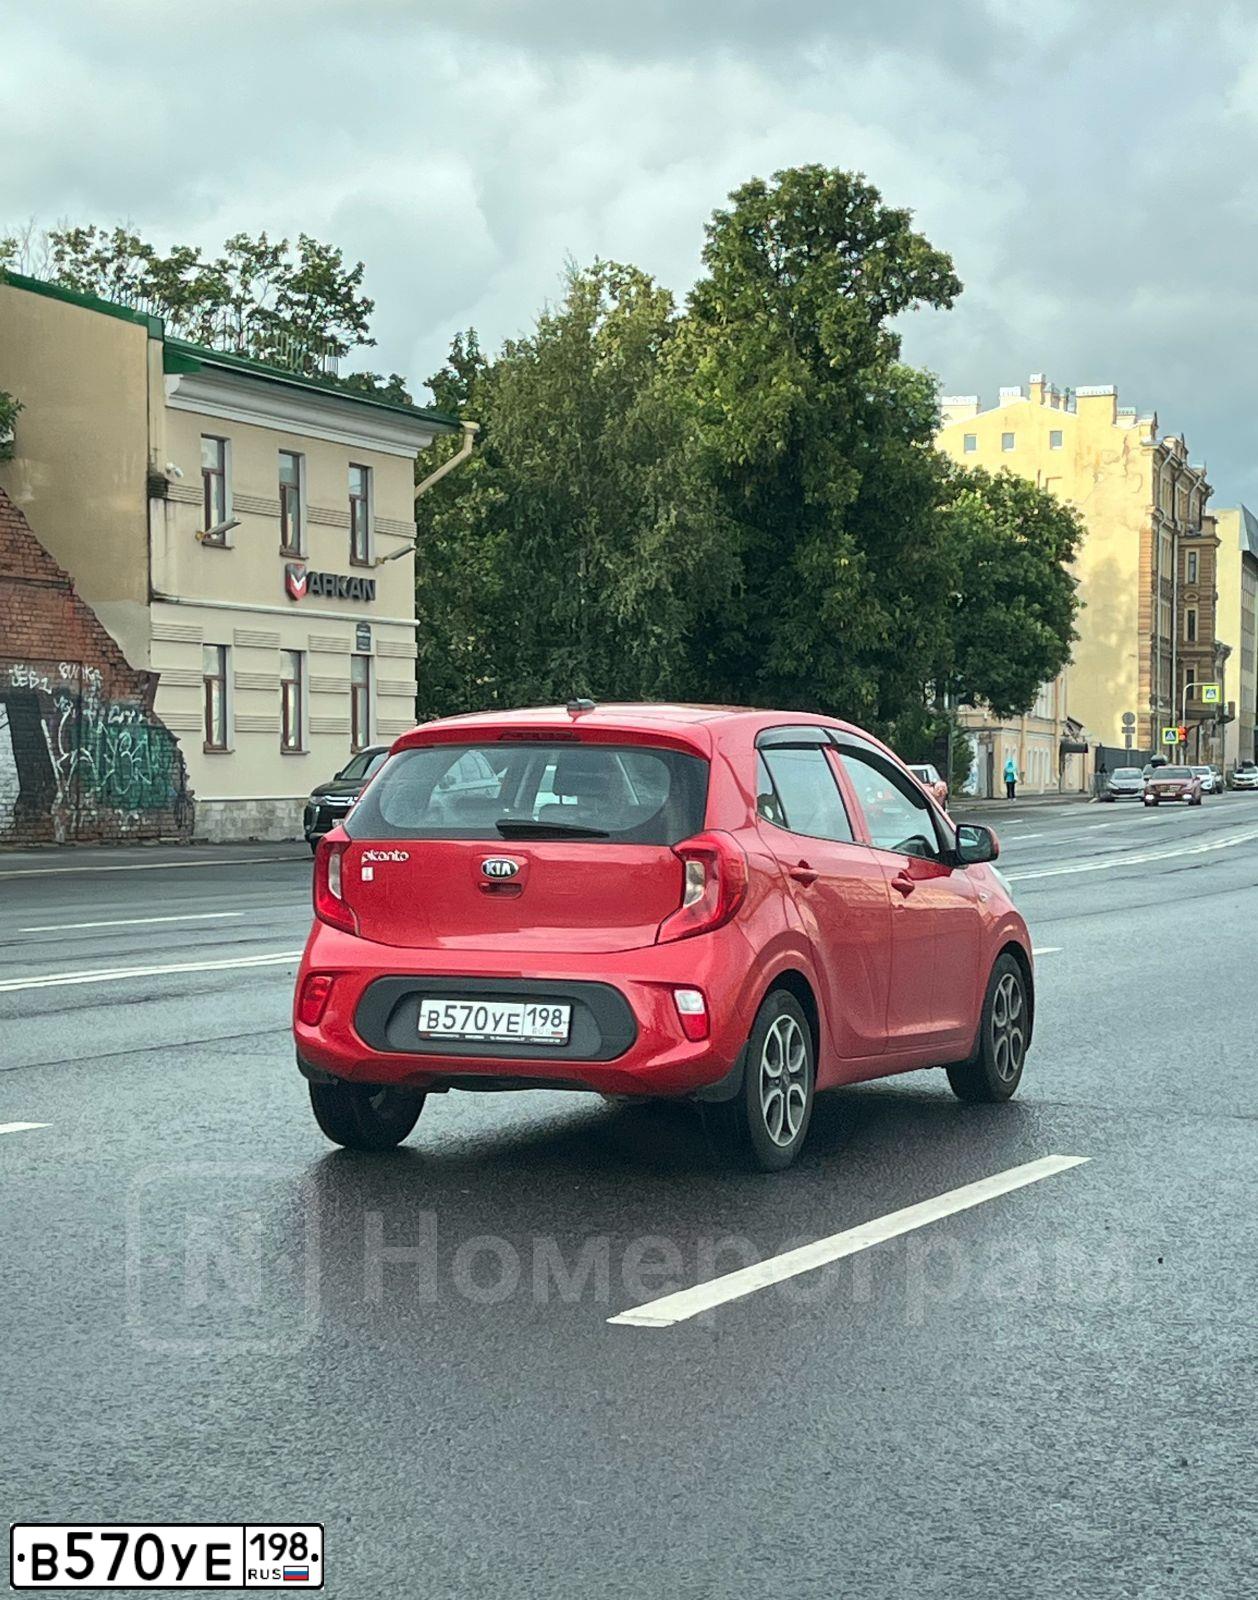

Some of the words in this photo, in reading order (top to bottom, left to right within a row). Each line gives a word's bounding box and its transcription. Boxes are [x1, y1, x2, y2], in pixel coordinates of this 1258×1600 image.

[307, 571, 376, 601] ARKAN
[486, 862, 511, 875] KIA
[427, 1004, 521, 1033] В570УЕ
[526, 1006, 563, 1028] 198
